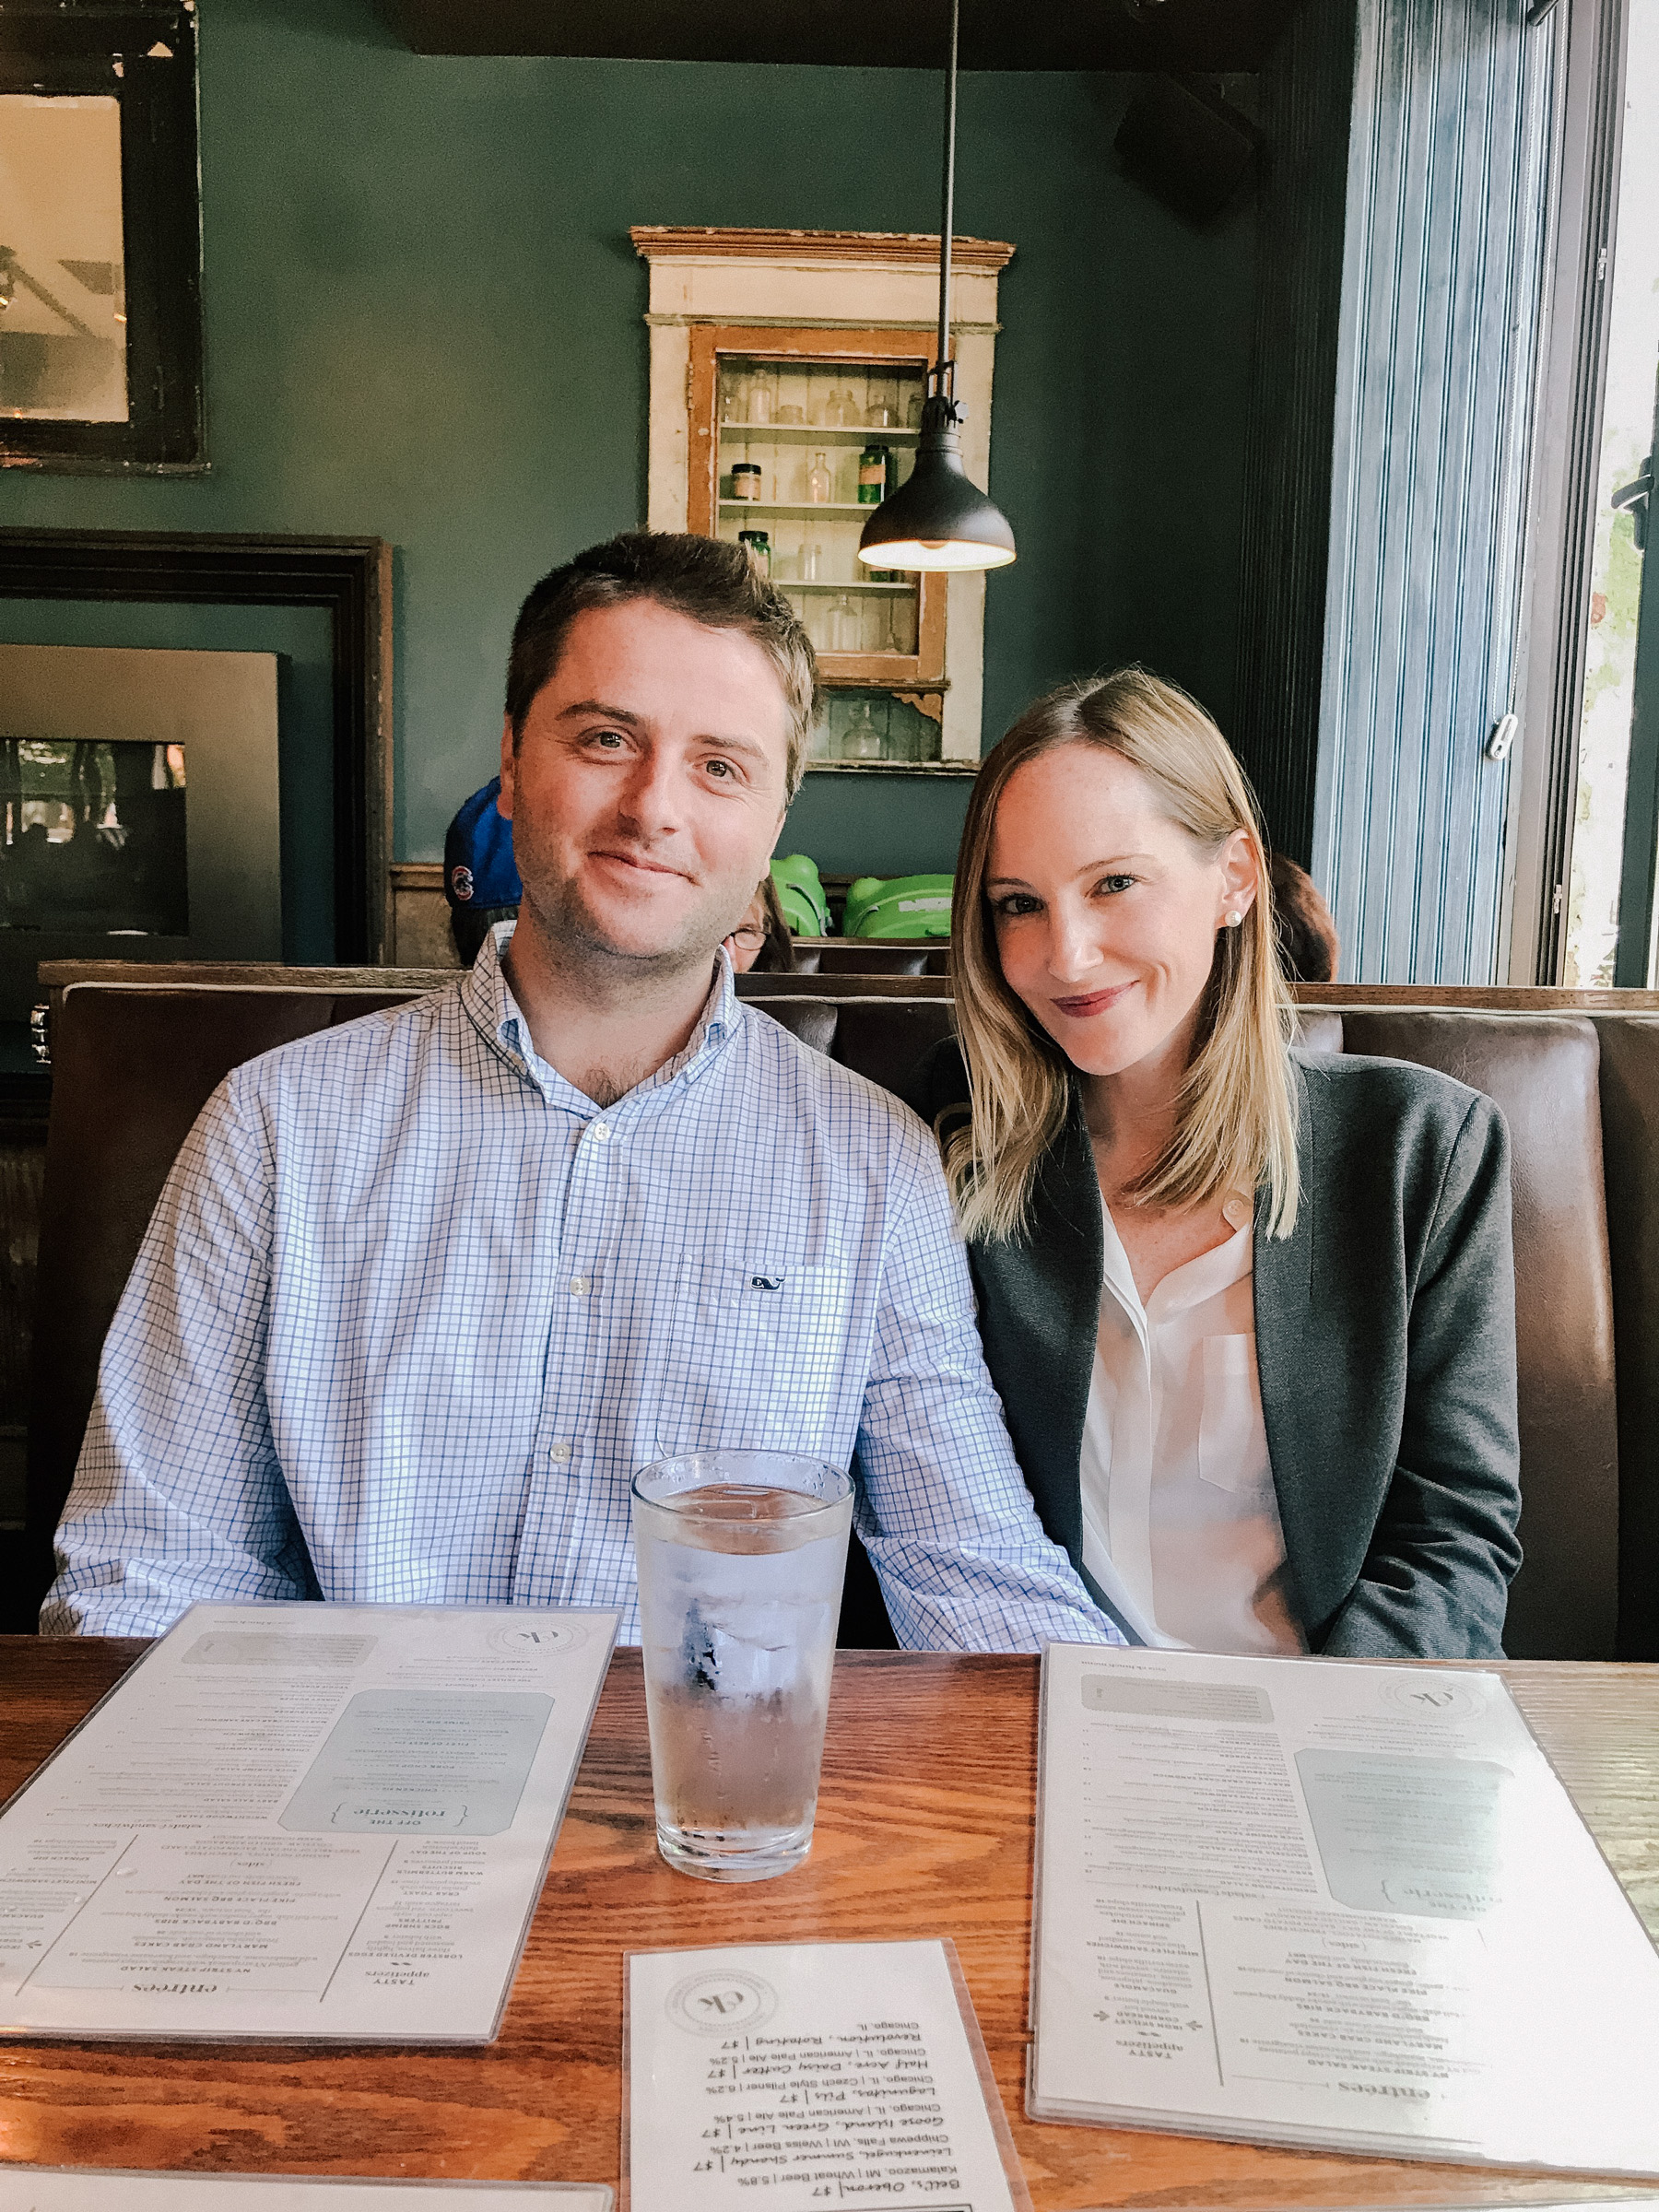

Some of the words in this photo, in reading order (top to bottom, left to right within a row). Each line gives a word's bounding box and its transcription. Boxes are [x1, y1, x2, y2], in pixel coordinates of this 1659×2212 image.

[353, 1808, 446, 1818] rotisserie
[871, 2021, 919, 2030] Chicago,
[721, 2040, 739, 2050] $7
[756, 2036, 822, 2047] Rotating
[1115, 2040, 1183, 2052] appetizers
[799, 2050, 853, 2059] American
[877, 2047, 925, 2056] Chicago,
[1129, 2049, 1172, 2059] TASTY
[771, 2053, 795, 2061] Pale
[798, 2062, 841, 2072] Daisy
[848, 2061, 889, 2070] Acre,
[895, 2058, 928, 2069] Half
[707, 2068, 725, 2079] $7
[741, 2065, 792, 2075] Cutter
[790, 2078, 818, 2088] Style
[822, 2077, 858, 2087] Czech
[868, 2077, 879, 2085] IL
[882, 2075, 934, 2084] Chicago,
[746, 2082, 786, 2091] Pilsner
[814, 2090, 846, 2102] Pils
[852, 2086, 935, 2099] Lagunitas,
[779, 2093, 798, 2103] $7
[874, 2106, 886, 2115] IL
[888, 2103, 941, 2112] Chicago,
[755, 2112, 774, 2121] Ale
[778, 2110, 805, 2119] Pale
[808, 2108, 864, 2118] American
[835, 2119, 893, 2130] Island,
[899, 2116, 944, 2126] Goose
[737, 2124, 775, 2136] Line
[783, 2122, 830, 2133] Green
[700, 2128, 721, 2138] $7
[785, 2139, 823, 2149] Weiss
[832, 2138, 851, 2147] WI
[889, 2134, 948, 2144] Chippewa
[710, 2145, 741, 2154] 4.2%
[753, 2141, 782, 2151] Beer
[730, 2155, 788, 2167] Shandy
[792, 2151, 854, 2162] Summer
[693, 2159, 713, 2171] $7
[814, 2171, 855, 2181] Wheat
[865, 2169, 881, 2178] MI
[885, 2166, 958, 2176] Kalamazoo,
[737, 2175, 770, 2186] 5.8%
[781, 2172, 810, 2183] Beer
[843, 2182, 905, 2194] Oberon
[911, 2179, 960, 2192] Bell's,
[812, 2185, 830, 2197] $7
